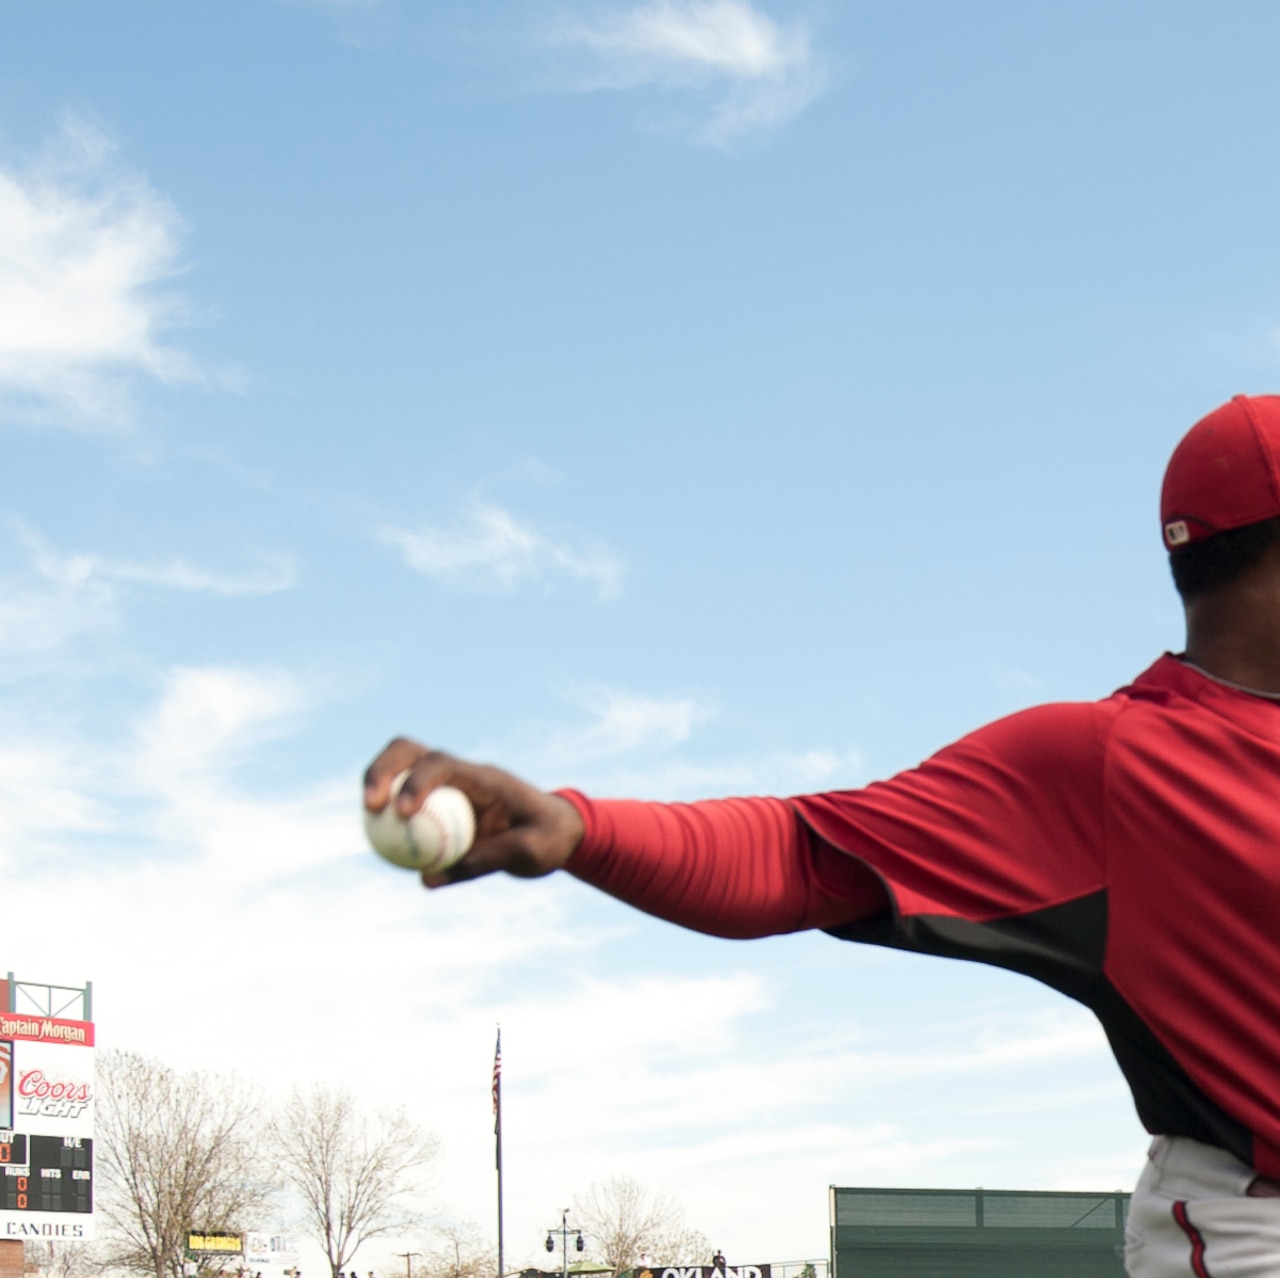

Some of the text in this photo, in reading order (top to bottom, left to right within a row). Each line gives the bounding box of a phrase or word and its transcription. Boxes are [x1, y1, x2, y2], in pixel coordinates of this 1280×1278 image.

[38, 1019, 86, 1043] Morgan
[18, 1070, 90, 1101] Coors
[18, 1099, 88, 1119] LIGHT
[7, 1222, 83, 1237] CANDIES
